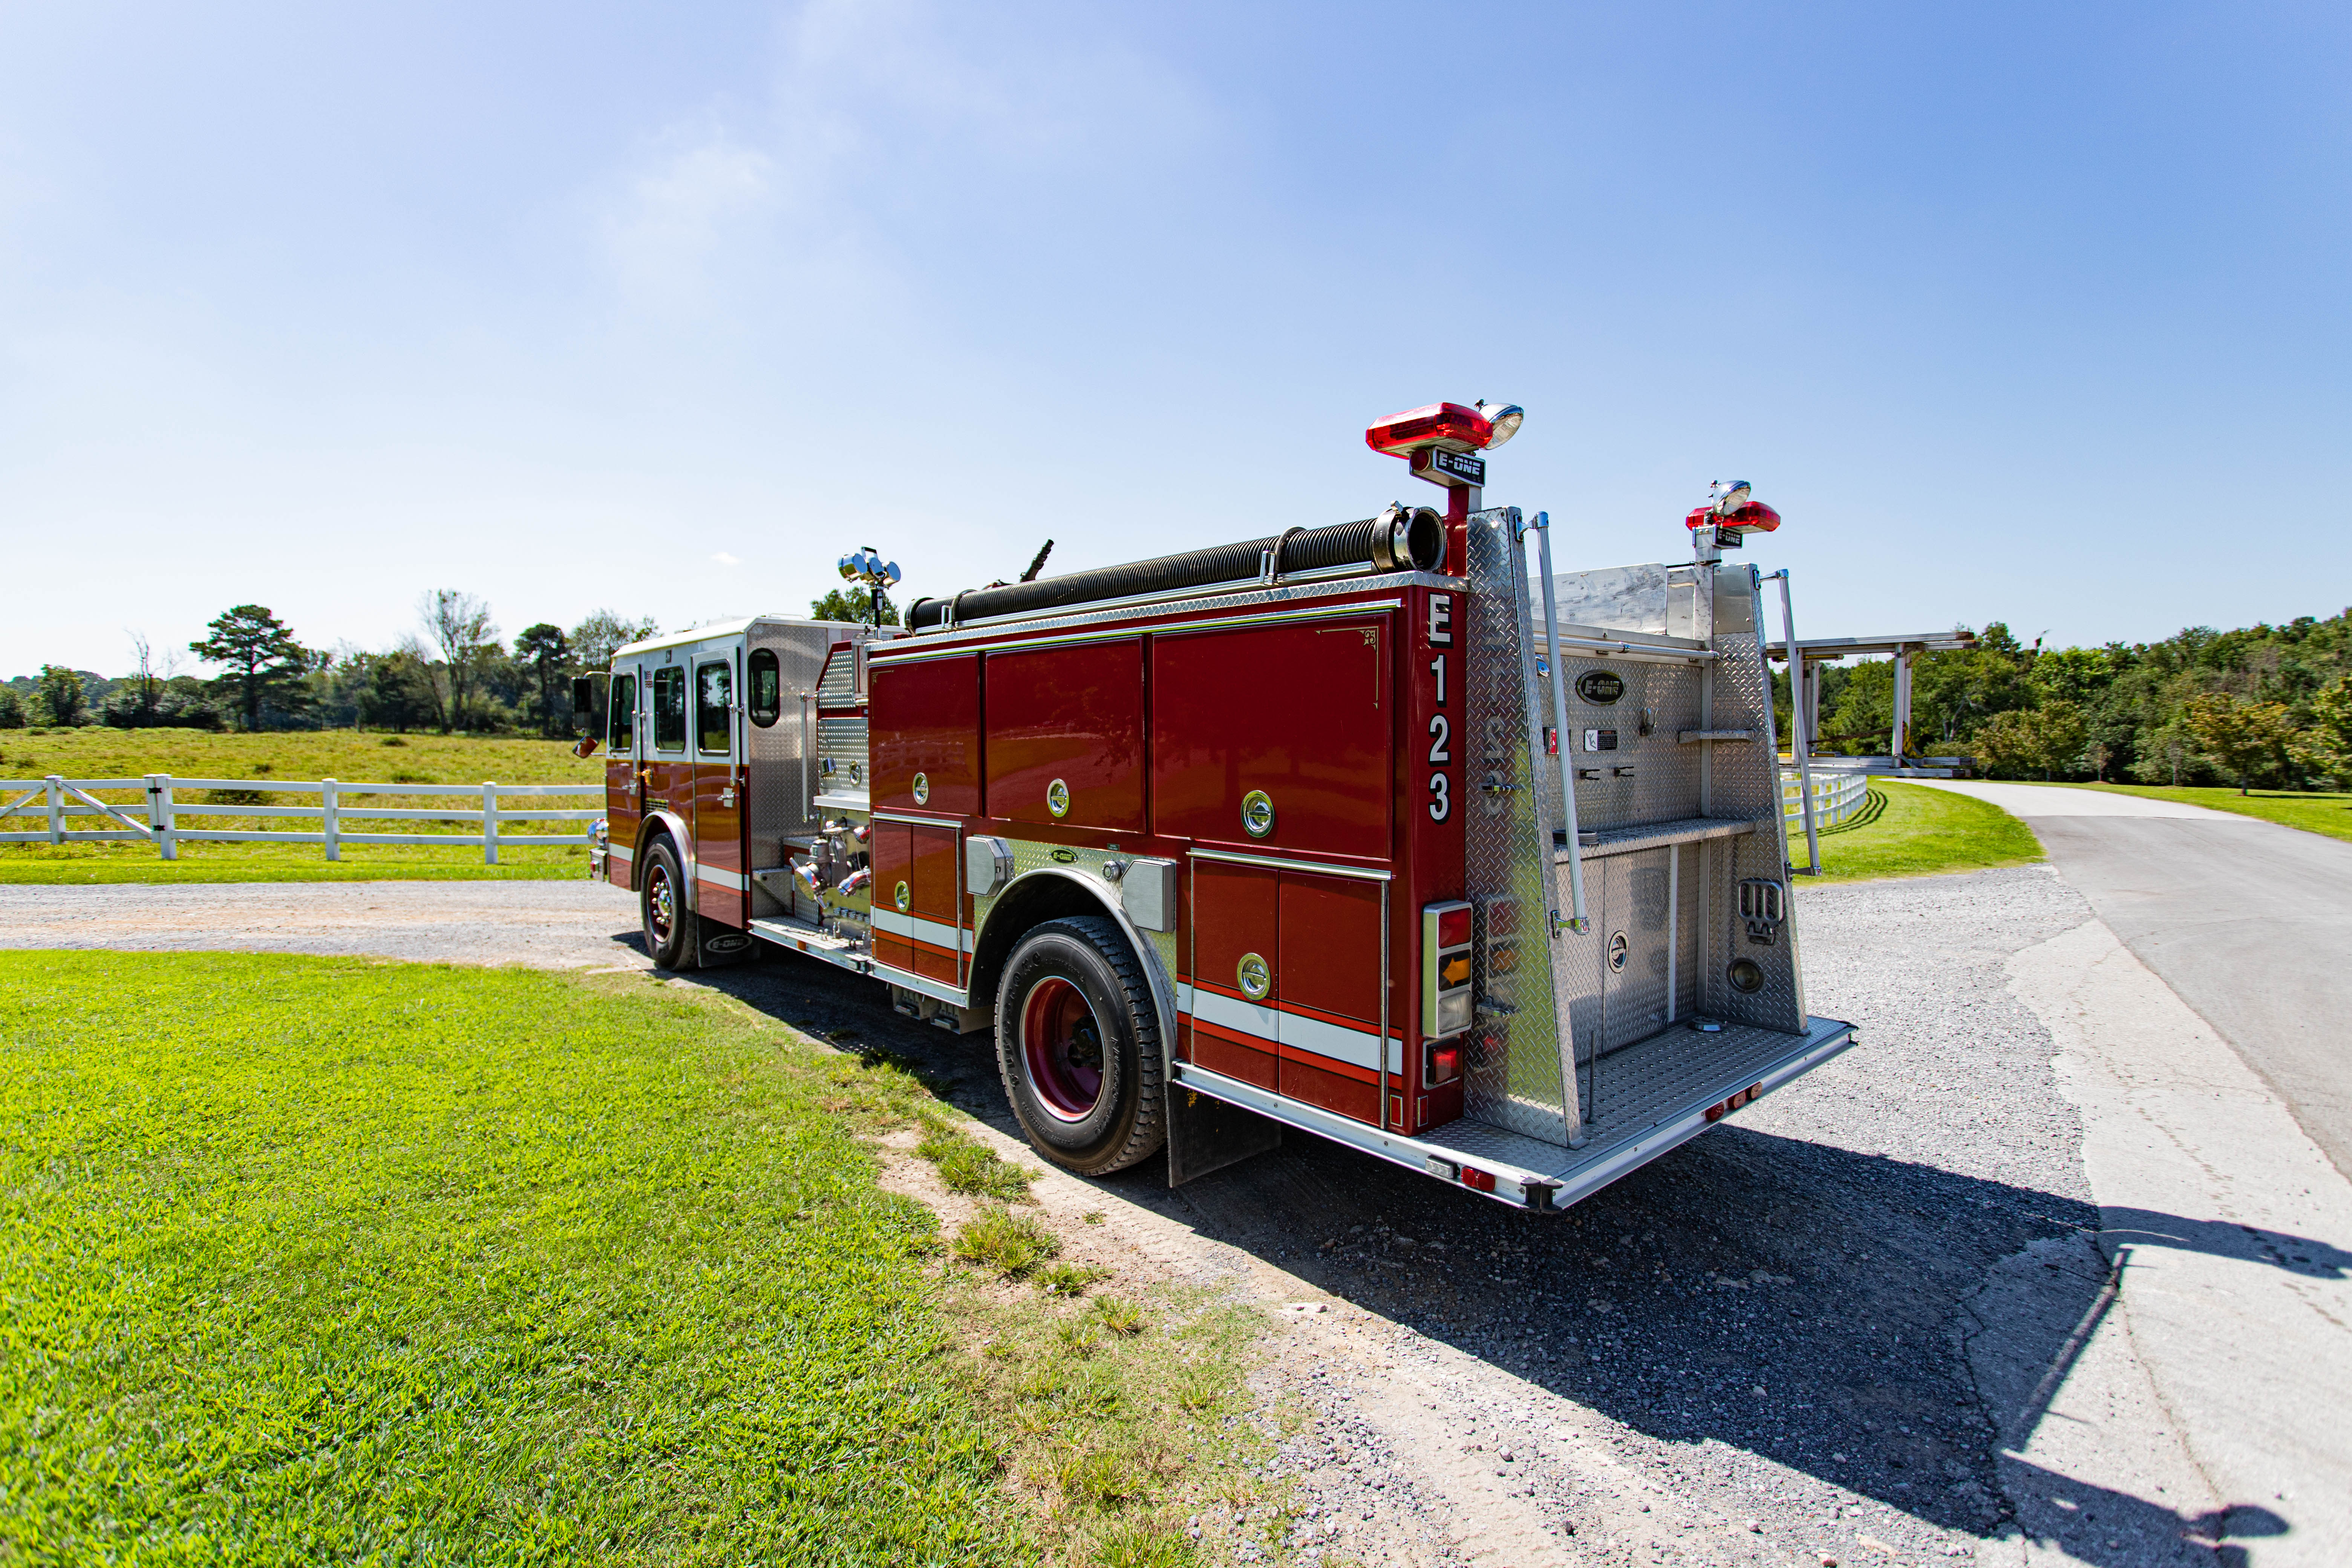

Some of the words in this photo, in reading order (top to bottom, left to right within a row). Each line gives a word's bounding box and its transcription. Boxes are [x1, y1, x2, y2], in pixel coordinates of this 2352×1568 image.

[1439, 452, 1481, 475] E-ONE
[1717, 529, 1740, 544] E-ONE
[1584, 680, 1620, 695] E-ONE
[1428, 593, 1452, 823] E123
[1053, 852, 1072, 861] E-ONE
[712, 939, 744, 949] E-ONE
